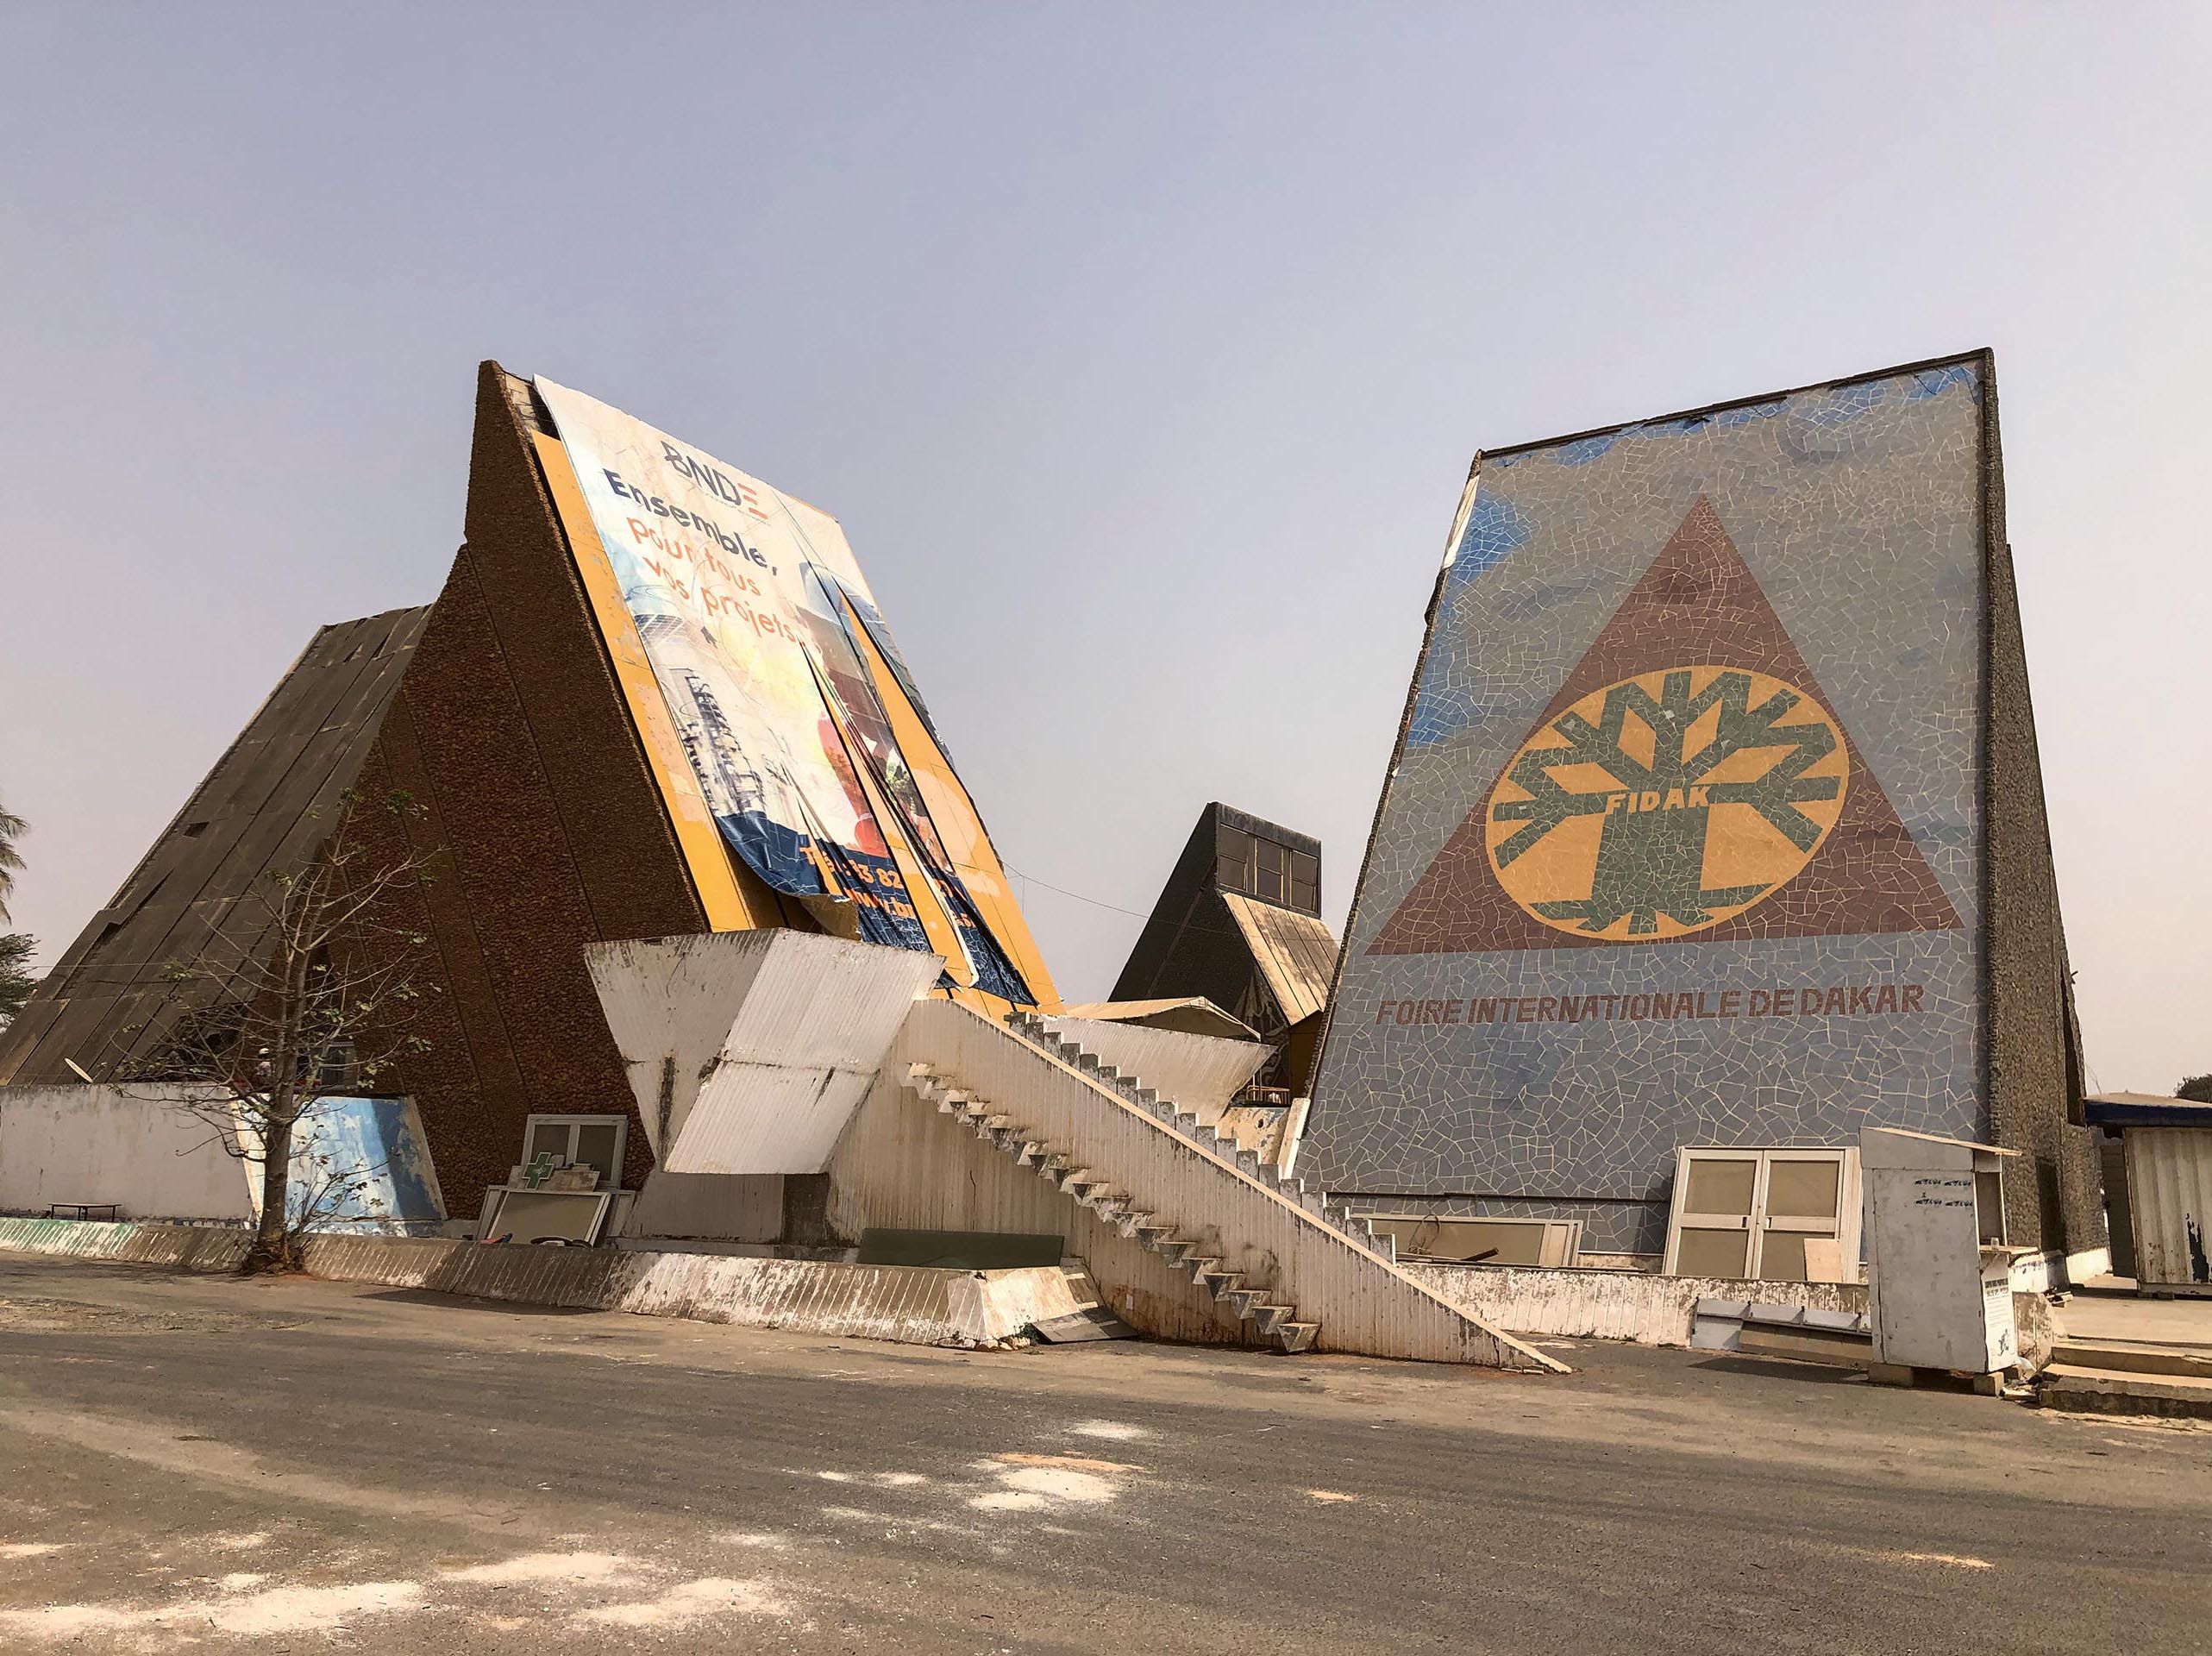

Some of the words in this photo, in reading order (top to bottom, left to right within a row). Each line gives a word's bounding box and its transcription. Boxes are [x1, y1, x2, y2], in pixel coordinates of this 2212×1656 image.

[661, 441, 768, 519] BNDE
[603, 468, 777, 576] Ensemble,
[627, 518, 693, 562] pour
[703, 548, 761, 596] tous
[643, 556, 690, 599] vos
[1605, 786, 1711, 815] FIDAK
[1375, 999, 1463, 1025] FOIRE
[1468, 990, 1740, 1025] INTERNATIONALE
[1748, 989, 1795, 1018] DE
[1800, 984, 1924, 1016] DAKAR
